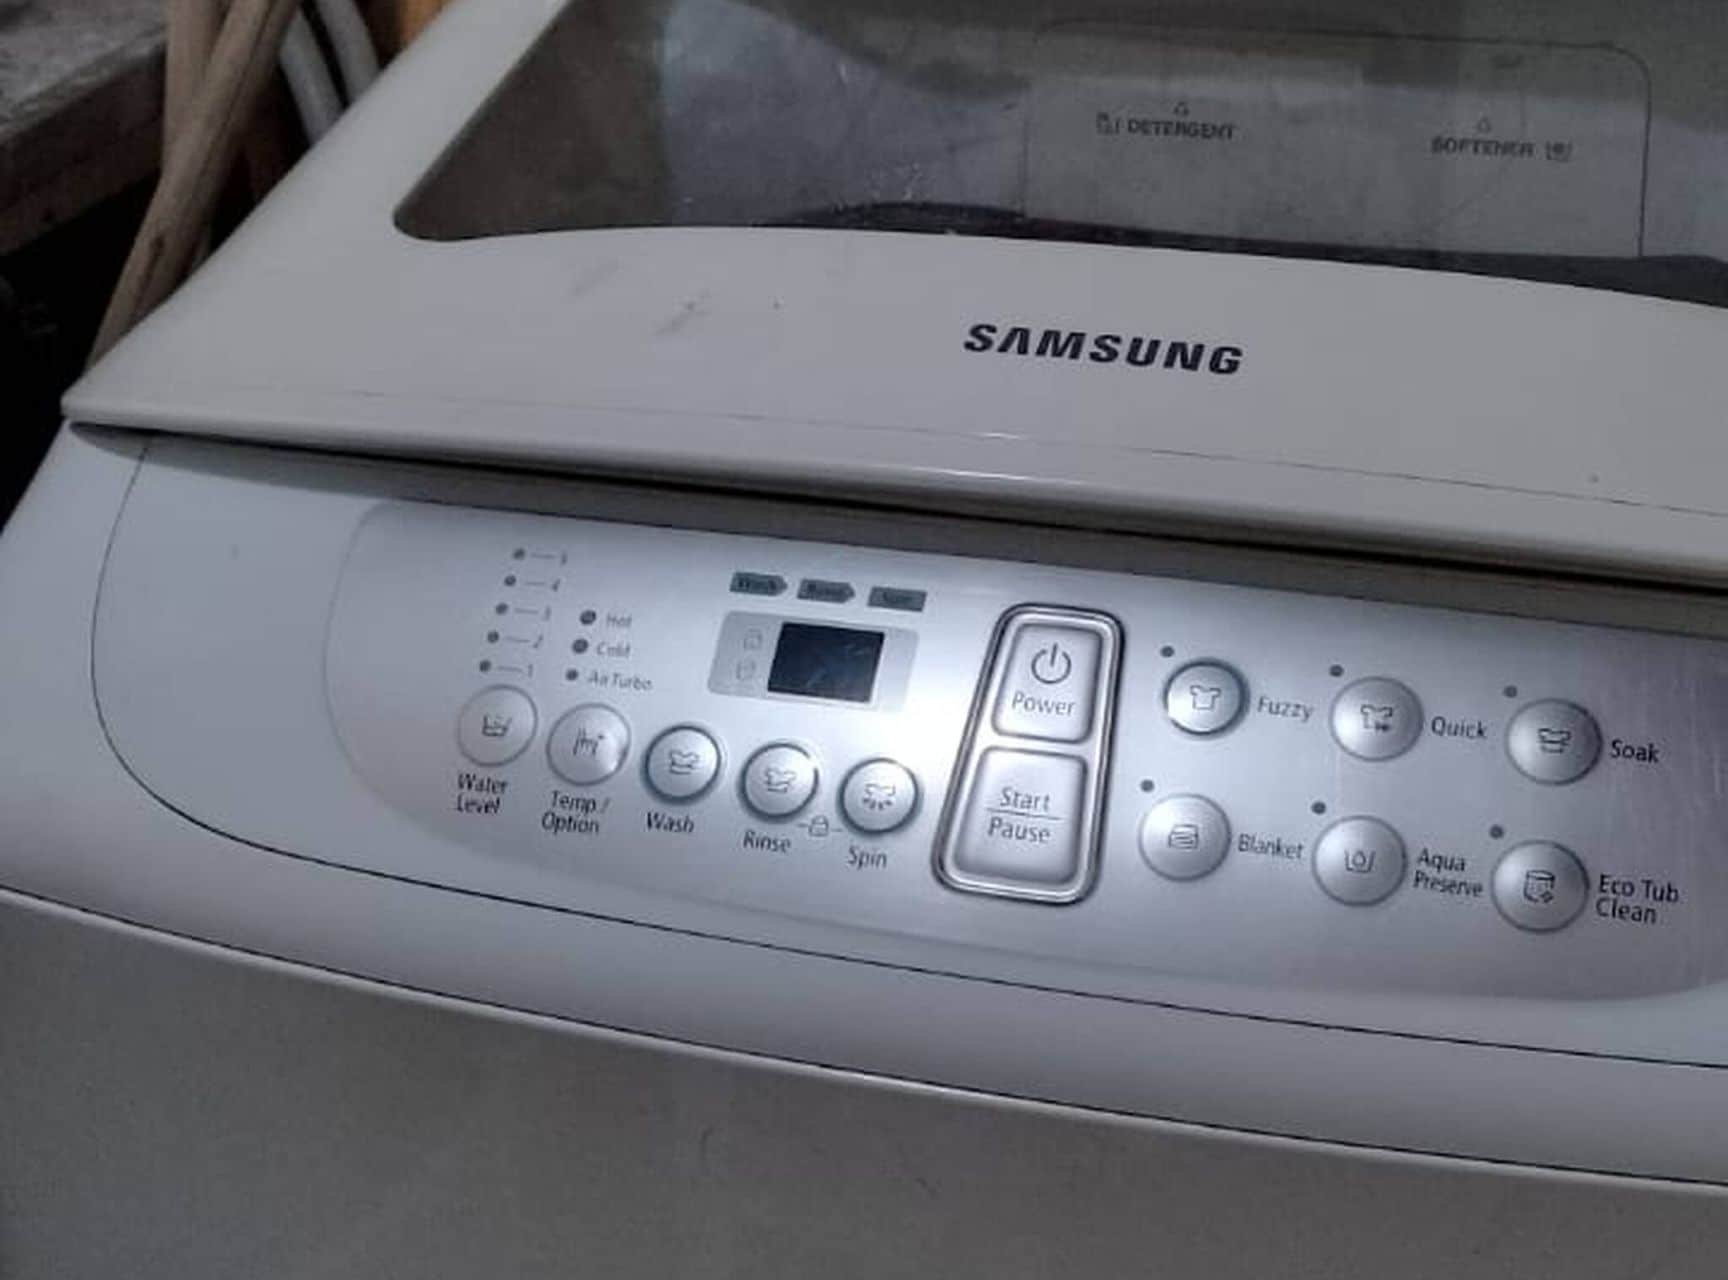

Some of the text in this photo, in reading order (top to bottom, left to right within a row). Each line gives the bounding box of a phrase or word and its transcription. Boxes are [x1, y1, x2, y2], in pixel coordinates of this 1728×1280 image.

[964, 324, 1243, 375] SAMSUNG
[1012, 690, 1077, 716] Power
[1257, 696, 1314, 722] Fuzzy
[1431, 716, 1488, 739] Quick
[1611, 739, 1660, 763] Soak
[458, 773, 508, 795] Water
[456, 793, 502, 814] Level
[552, 790, 598, 814] Temp
[1000, 786, 1051, 812] Start
[541, 811, 601, 834] Option
[646, 811, 695, 834] Wash
[988, 816, 1052, 843] Pause
[742, 830, 791, 854] Rinse
[1238, 833, 1304, 860] Blanket
[848, 844, 888, 869] Spin
[1418, 847, 1467, 873] Aqua
[1413, 870, 1484, 897] Preserve
[1600, 873, 1680, 903] Eco Tub
[1596, 897, 1658, 925] Clean
